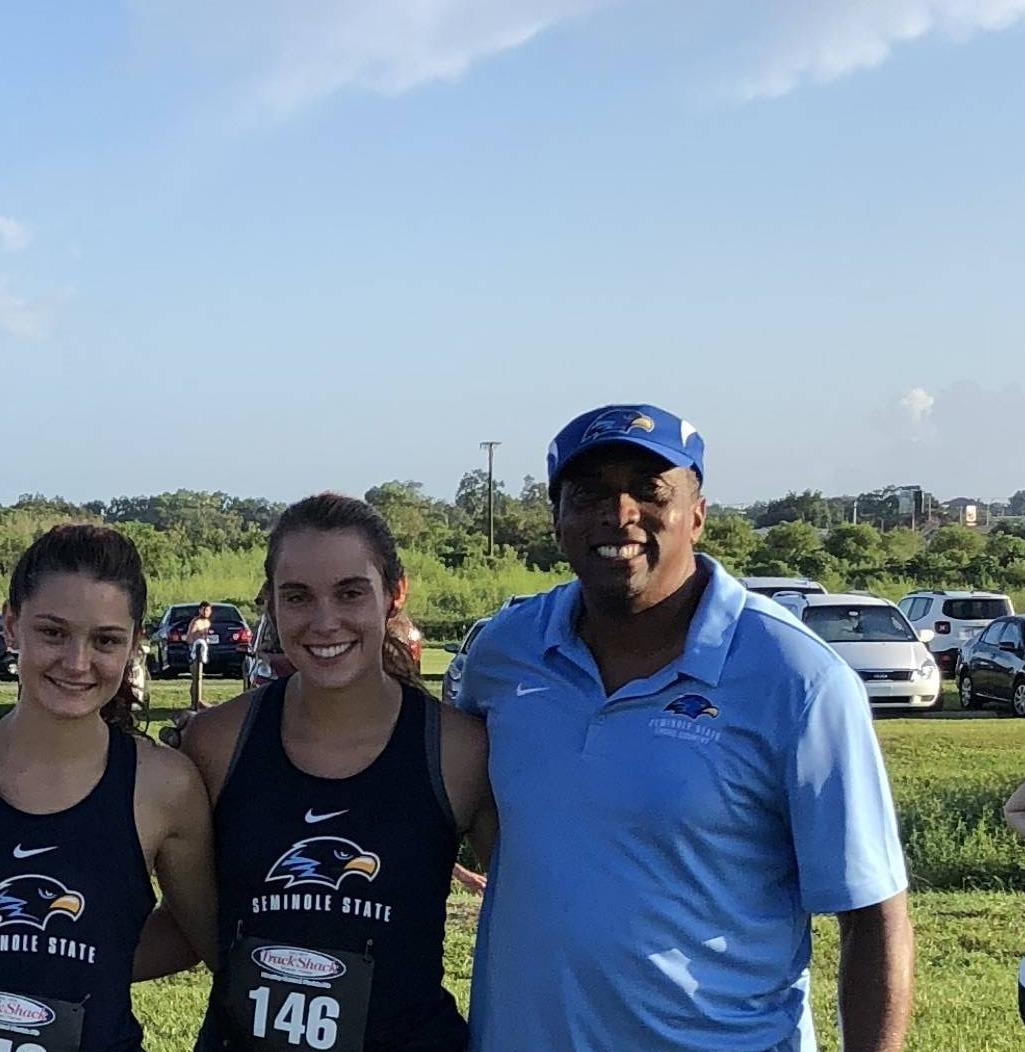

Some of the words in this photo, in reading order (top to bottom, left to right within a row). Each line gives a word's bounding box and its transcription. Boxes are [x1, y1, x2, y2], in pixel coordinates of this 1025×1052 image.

[252, 893, 332, 914] SEMINOLE
[342, 897, 392, 922] STATE
[48, 937, 96, 964] STATE
[249, 986, 340, 1050] 146
